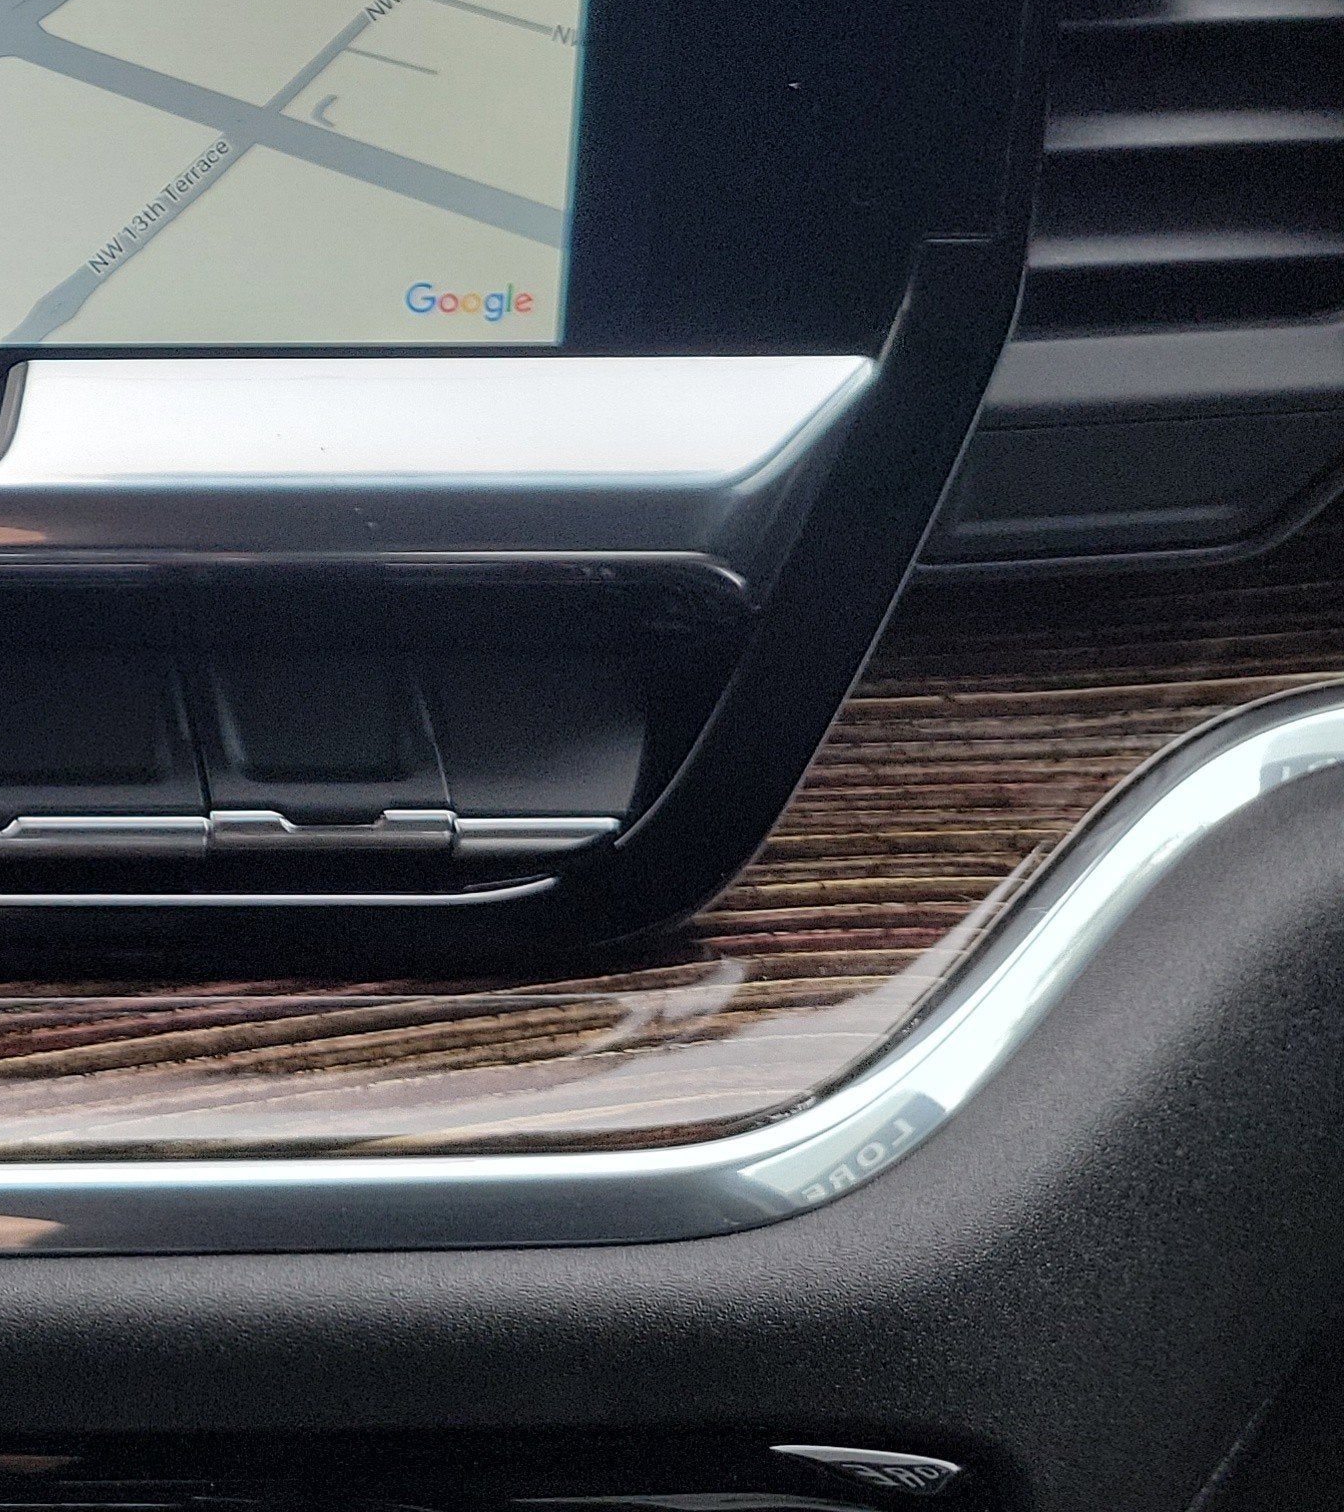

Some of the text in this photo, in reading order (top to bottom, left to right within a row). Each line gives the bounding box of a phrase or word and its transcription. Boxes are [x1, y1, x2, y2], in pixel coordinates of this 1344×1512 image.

[87, 137, 231, 276] NW 13th Terrace
[404, 281, 535, 323] Google
